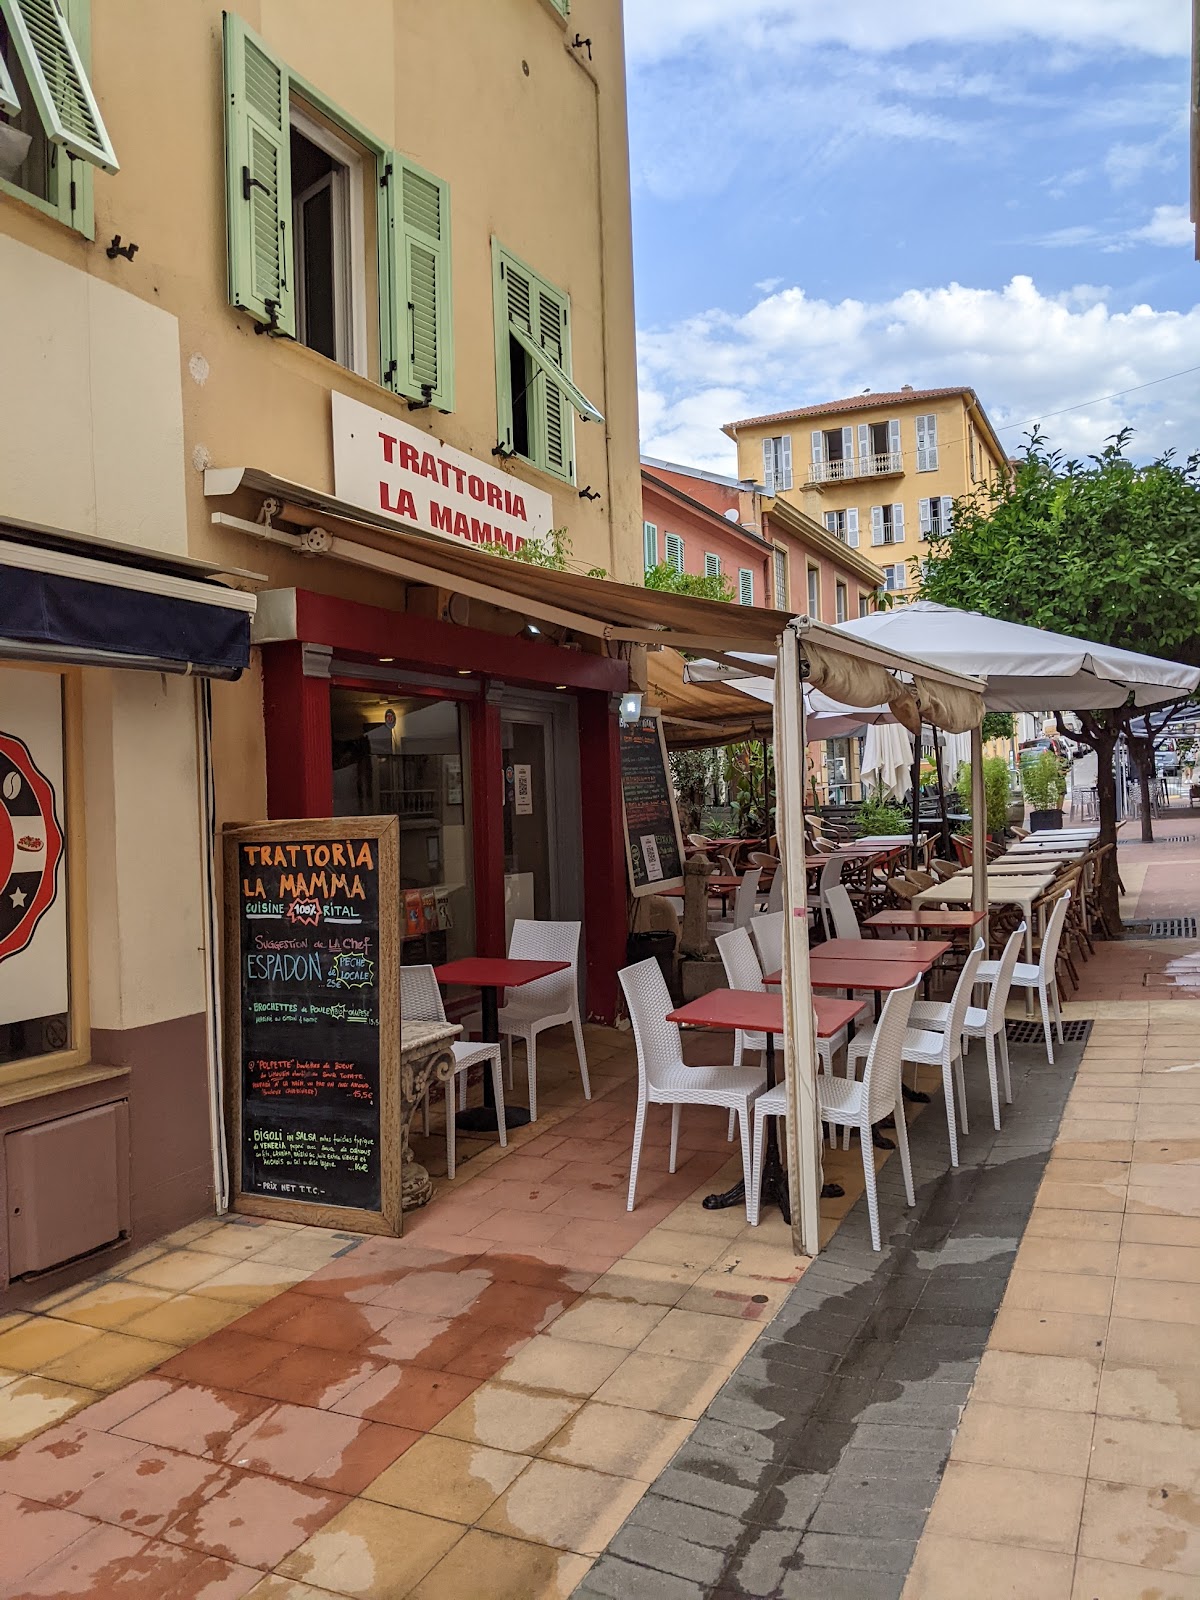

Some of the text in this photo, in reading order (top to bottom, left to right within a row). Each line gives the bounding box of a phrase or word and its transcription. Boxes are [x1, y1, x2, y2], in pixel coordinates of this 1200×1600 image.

[379, 431, 527, 522] TRATTORIA
[379, 481, 418, 521] LA
[243, 839, 374, 871] TRATTORIA
[243, 870, 366, 900] LA MAMMA
[294, 903, 317, 915] 100%
[328, 938, 341, 949] LA
[247, 951, 323, 981] ESPADON
[340, 970, 369, 981] LOCALE
[253, 1002, 298, 1013] BROCHETTES
[296, 1131, 317, 1141] SALSA
[281, 1183, 296, 1192] NET
